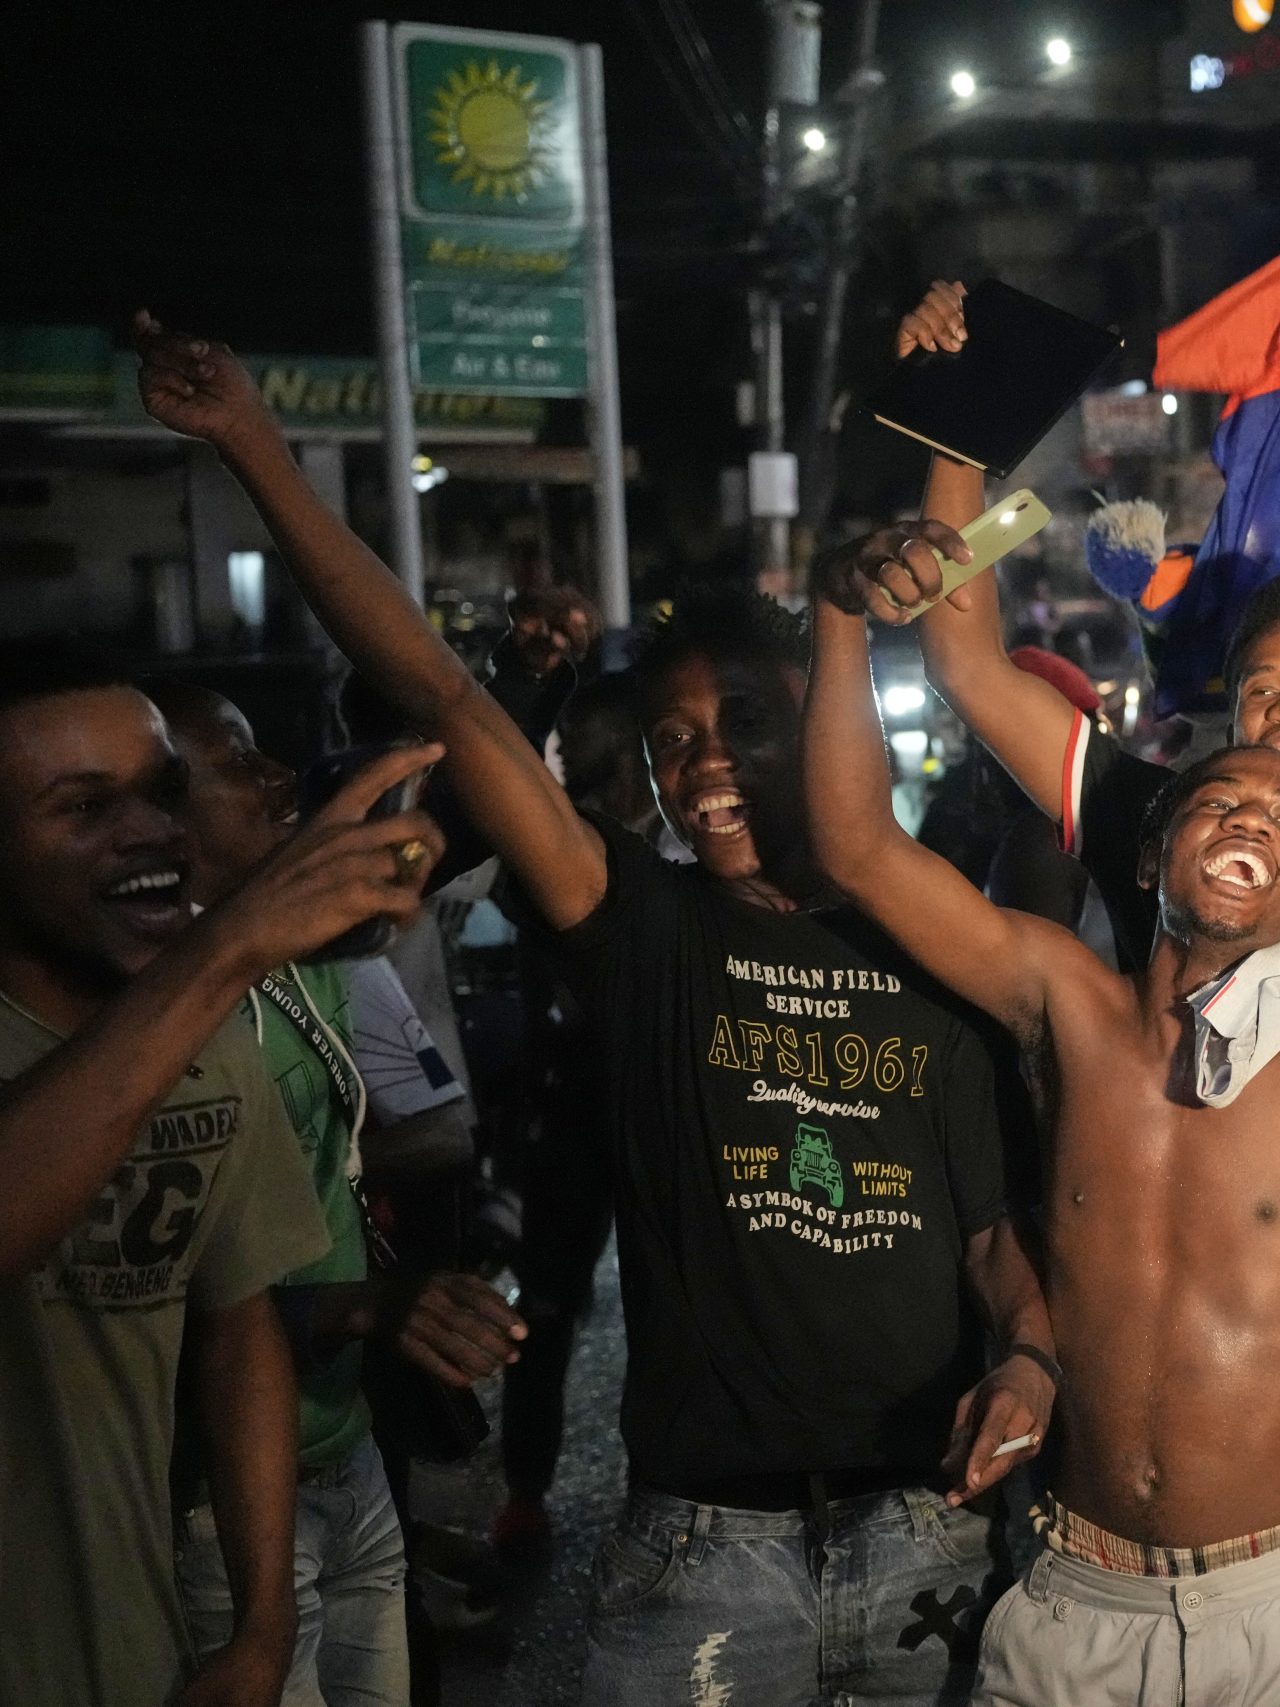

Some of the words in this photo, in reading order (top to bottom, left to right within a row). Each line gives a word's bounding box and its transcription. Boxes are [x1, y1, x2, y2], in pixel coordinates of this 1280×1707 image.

[726, 954, 825, 990] AMERICAN
[832, 969, 901, 993] FIELD
[261, 977, 308, 1029] YOUNG
[766, 992, 851, 1019] SERVICE
[723, 1144, 779, 1162] LIVING
[733, 1164, 768, 1180] LIFE
[852, 1161, 912, 1184] WITHOUT
[862, 1180, 907, 1197] LIMITS
[740, 1190, 813, 1217] SYMBOK
[816, 1206, 837, 1225] OF
[841, 1208, 922, 1231] FREEDOM
[749, 1212, 787, 1231] AND
[790, 1219, 894, 1254] CAPABILITY
